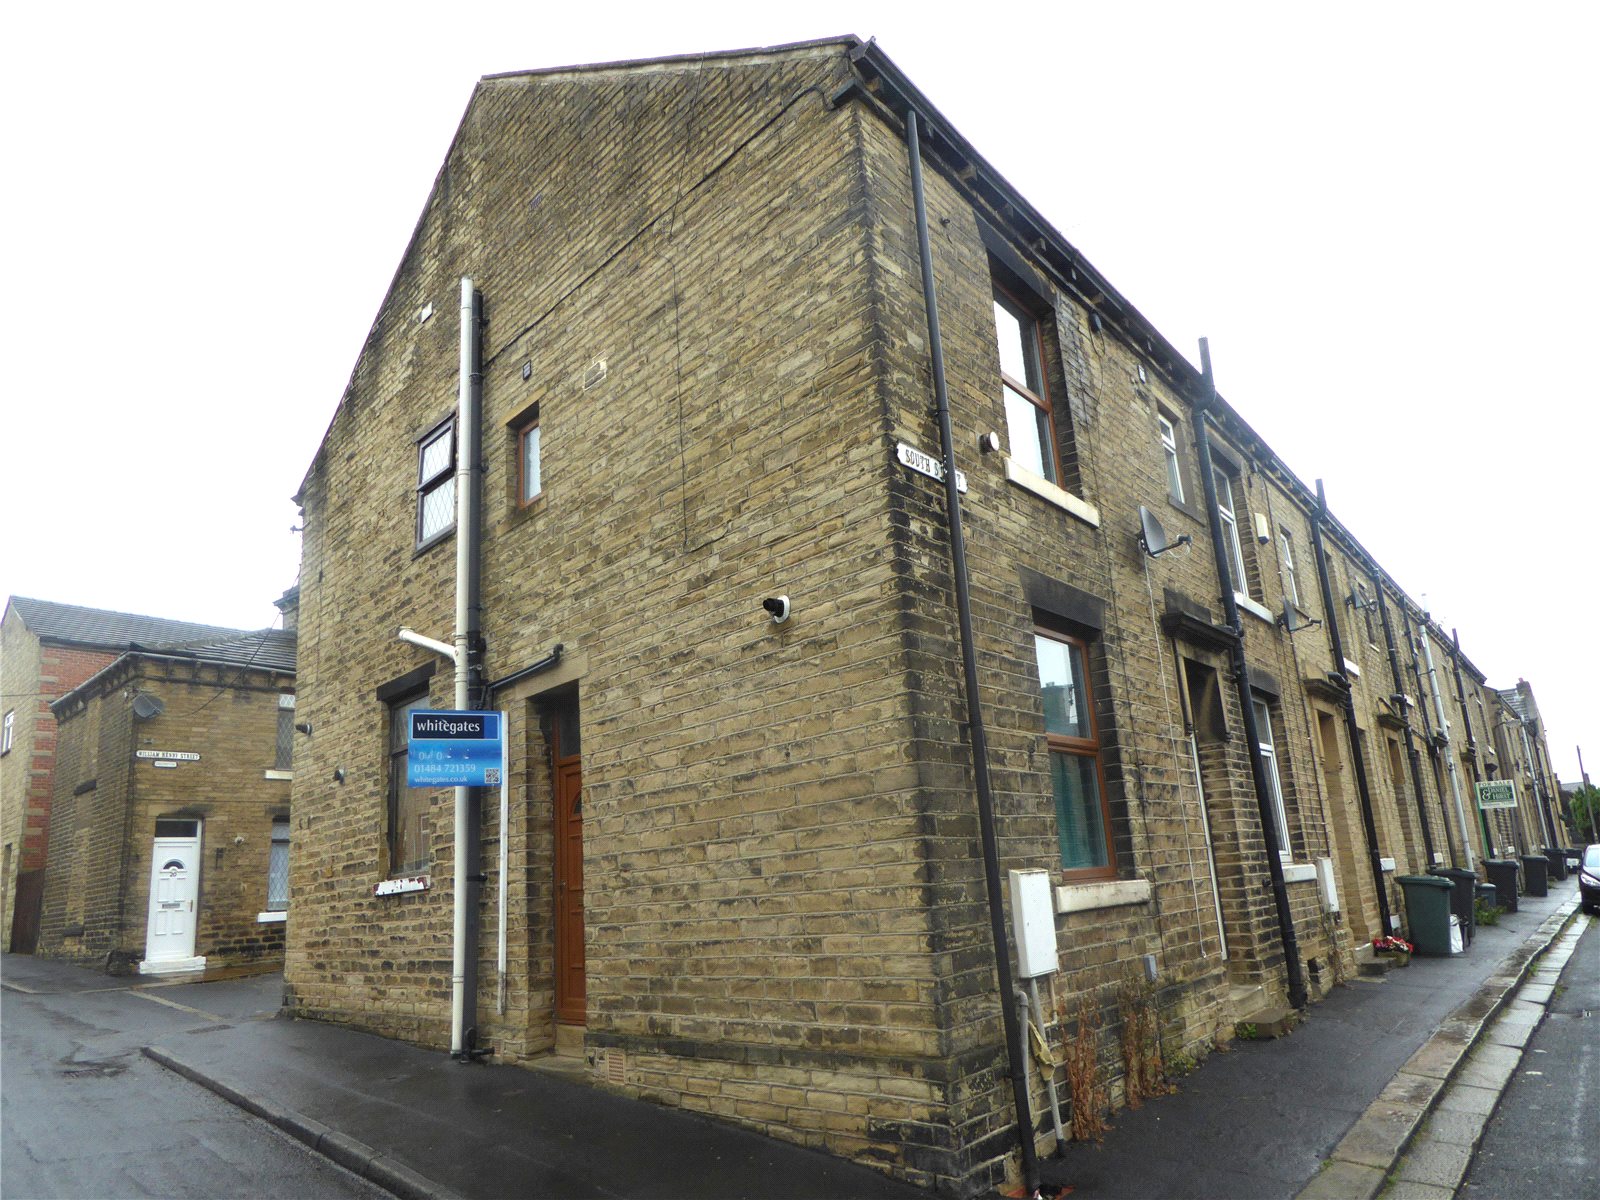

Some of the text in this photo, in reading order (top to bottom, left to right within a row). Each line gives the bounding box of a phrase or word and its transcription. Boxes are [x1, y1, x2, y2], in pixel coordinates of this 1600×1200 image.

[905, 449, 931, 473] SOUTH
[417, 719, 480, 735] whitegates
[414, 764, 476, 773] 01484 721359
[414, 775, 468, 784] whitegates.co.uk
